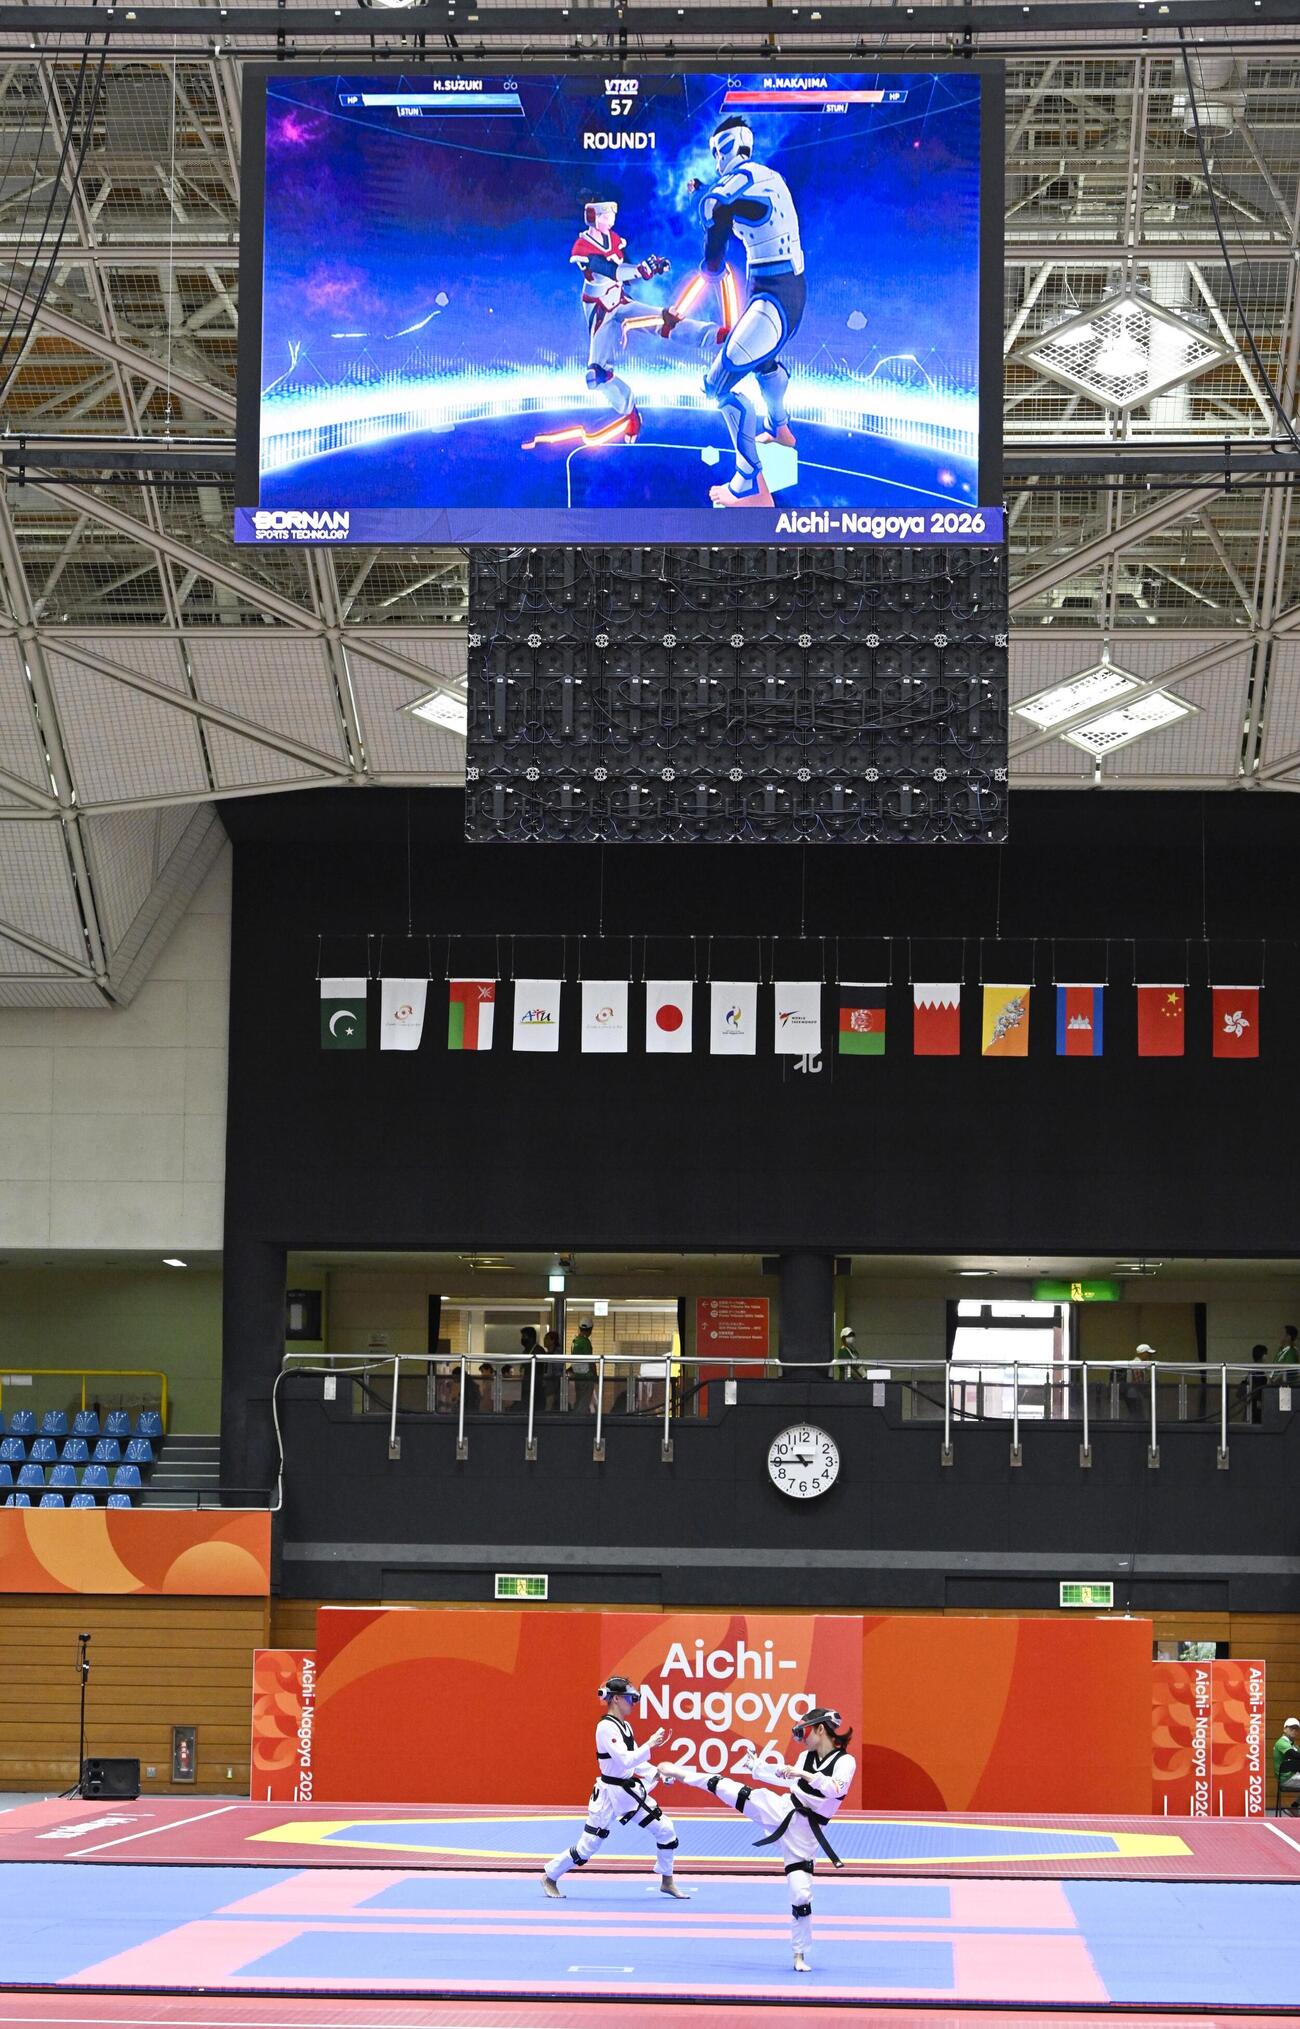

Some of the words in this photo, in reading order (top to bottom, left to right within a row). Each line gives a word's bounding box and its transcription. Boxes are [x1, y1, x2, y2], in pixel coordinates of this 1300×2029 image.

[433, 80, 483, 91] H.SUZUKI
[763, 77, 828, 90] M.NAKAJIMA
[347, 96, 359, 105] HP
[889, 92, 900, 101] HP
[400, 107, 419, 116] STUN
[610, 99, 633, 116] 57
[826, 104, 844, 112] STUN
[252, 511, 350, 529] BORNAN
[775, 511, 925, 538] Aichi-Nagoya
[930, 513, 986, 533] 2026
[255, 530, 289, 539] SPORTS
[291, 530, 350, 539] TECHNOLOGY
[799, 1431, 811, 1443] 12
[777, 1443, 788, 1455] 10
[822, 1443, 830, 1454] 2
[773, 1456, 782, 1467] 9
[825, 1456, 834, 1467] 3
[778, 1468, 787, 1479] 8
[820, 1468, 829, 1479] 4
[788, 1478, 796, 1489] 7
[799, 1481, 807, 1492] 6
[812, 1478, 820, 1489] 5
[659, 1638, 797, 1680] Aichi-
[297, 1658, 317, 1767] Aichi-Nagoya
[639, 1684, 817, 1733] Nagoya
[1191, 1669, 1210, 1777] Aichi-Nagoya
[1245, 1667, 1263, 1772] Aichi-Nagoya
[670, 1737, 785, 1775] 2026
[1249, 1775, 1262, 1813] 2026
